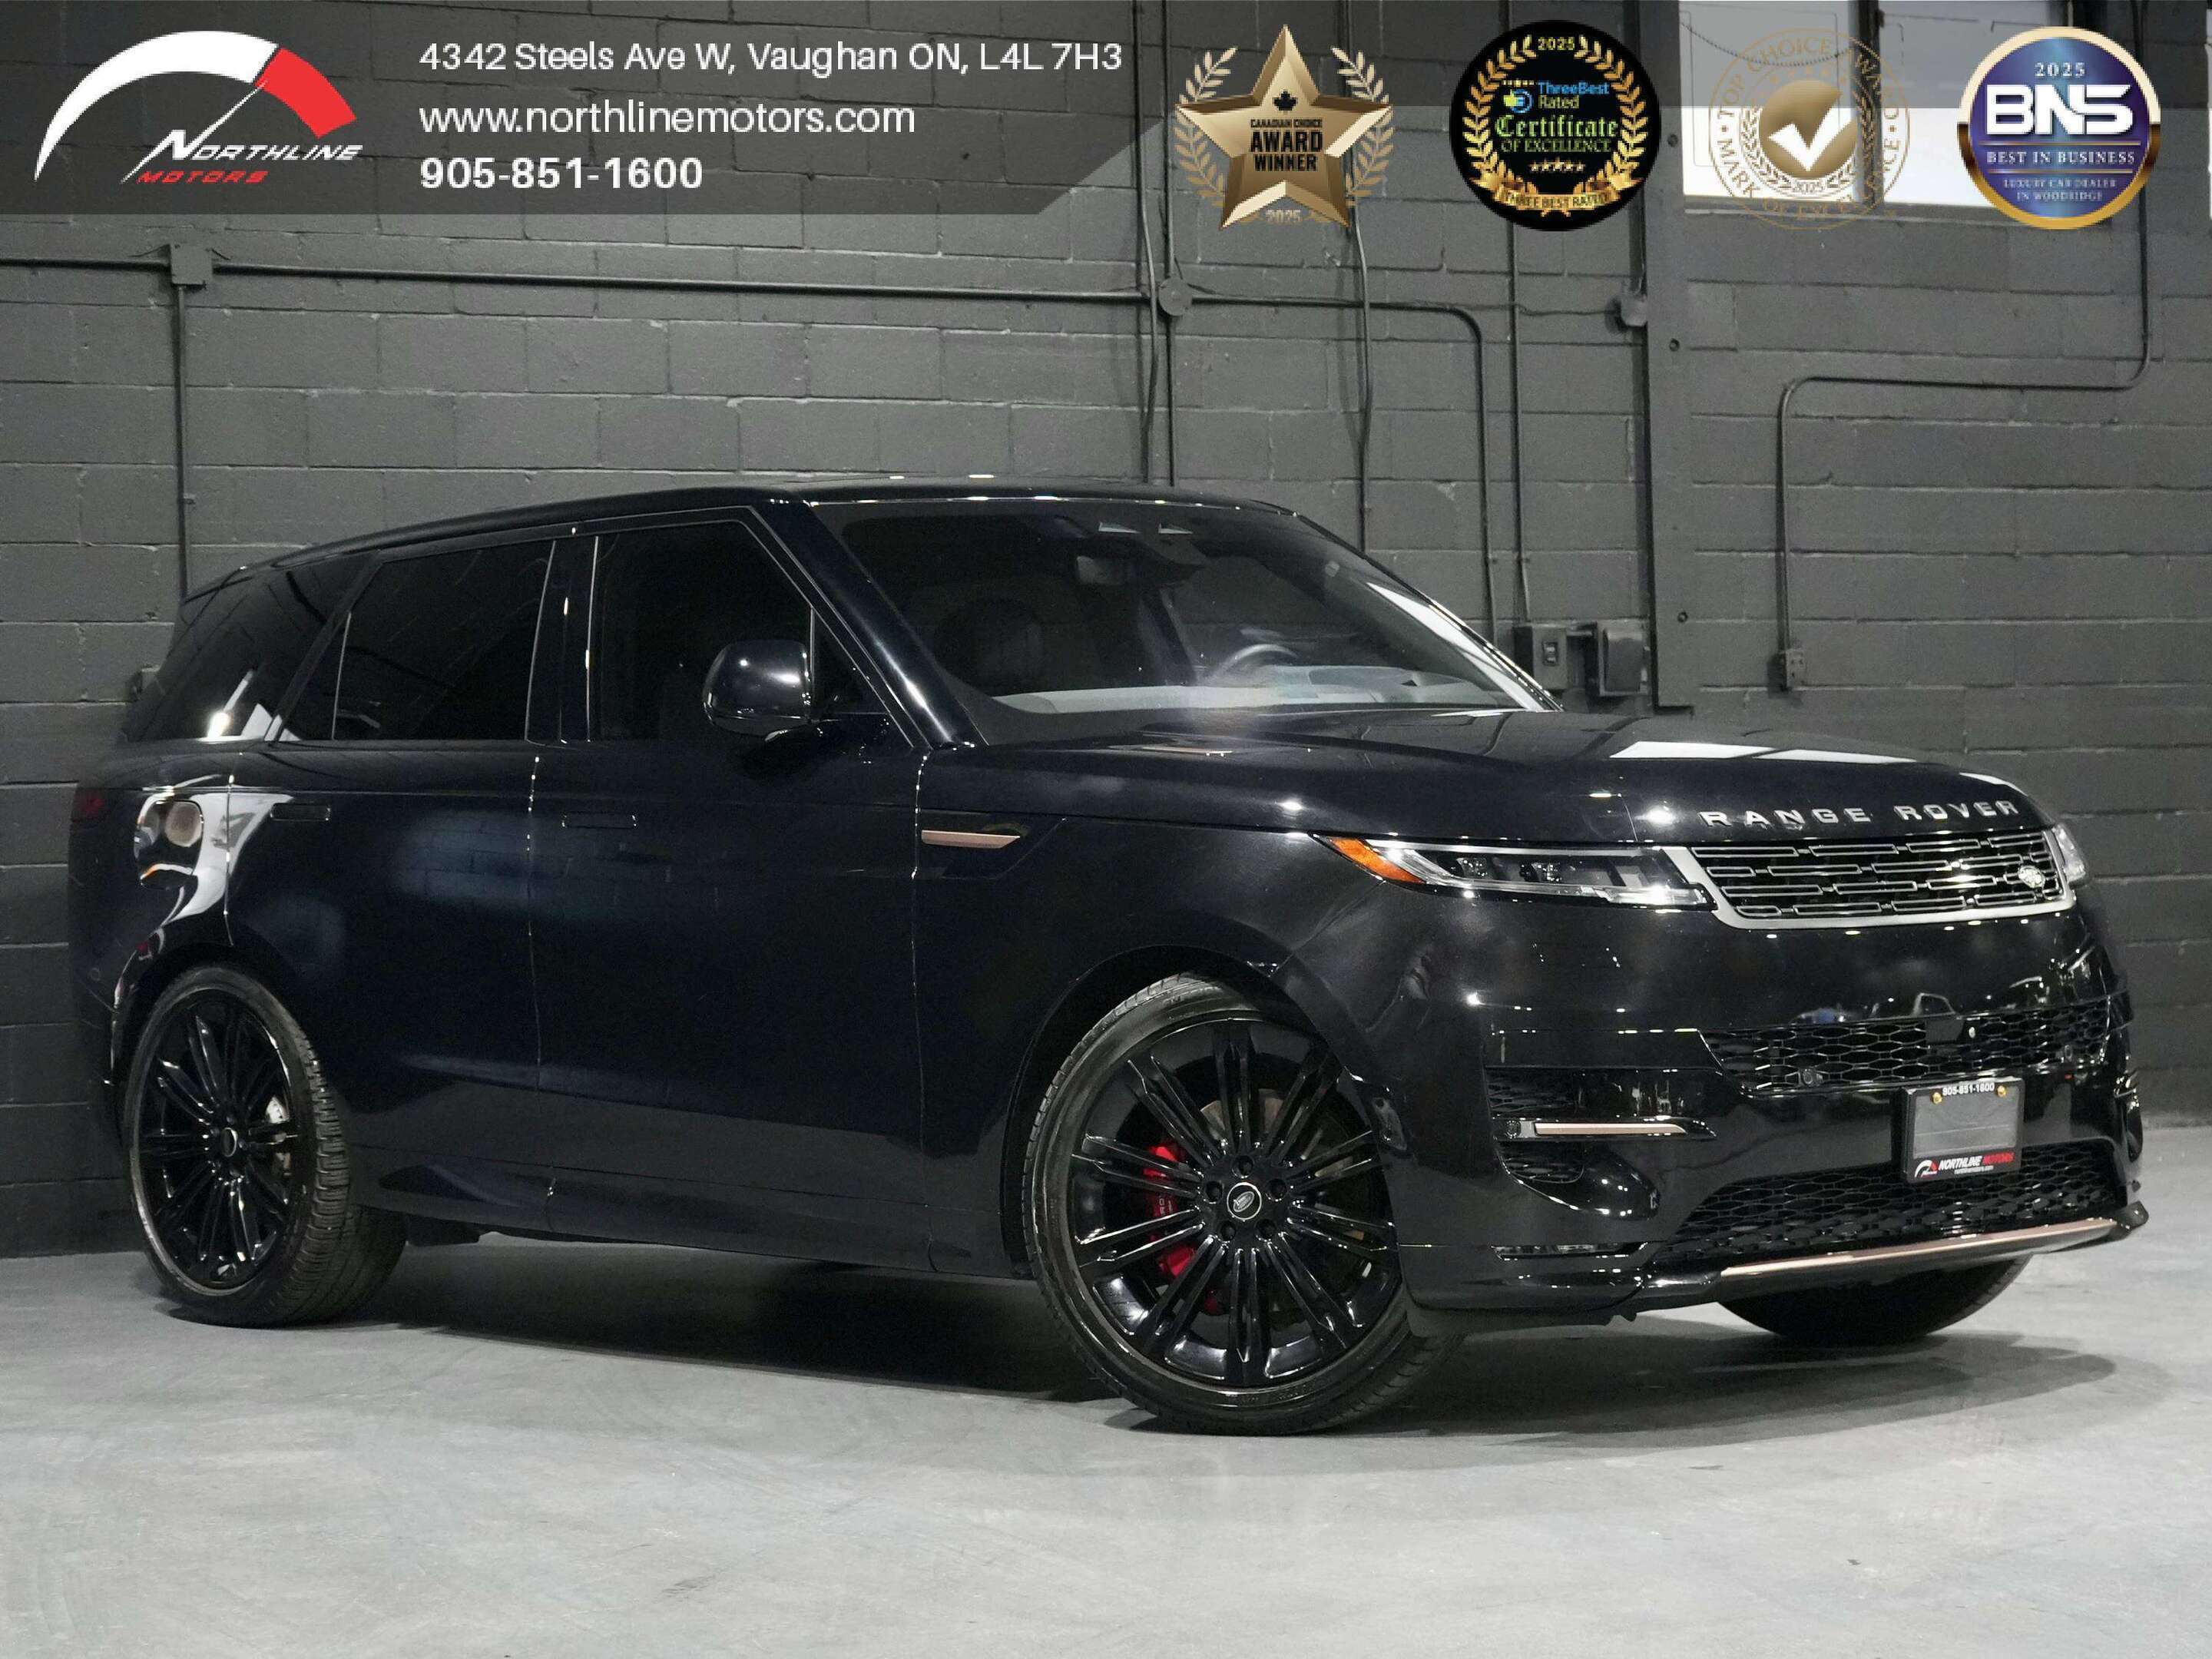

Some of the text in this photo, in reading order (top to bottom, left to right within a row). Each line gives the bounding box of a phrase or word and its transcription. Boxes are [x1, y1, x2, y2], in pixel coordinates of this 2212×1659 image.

[1699, 800, 2020, 828] RANGE ROVER
[1942, 1082, 1995, 1096] 905-851-1600
[1938, 1155, 1983, 1171] NORTHLINE
